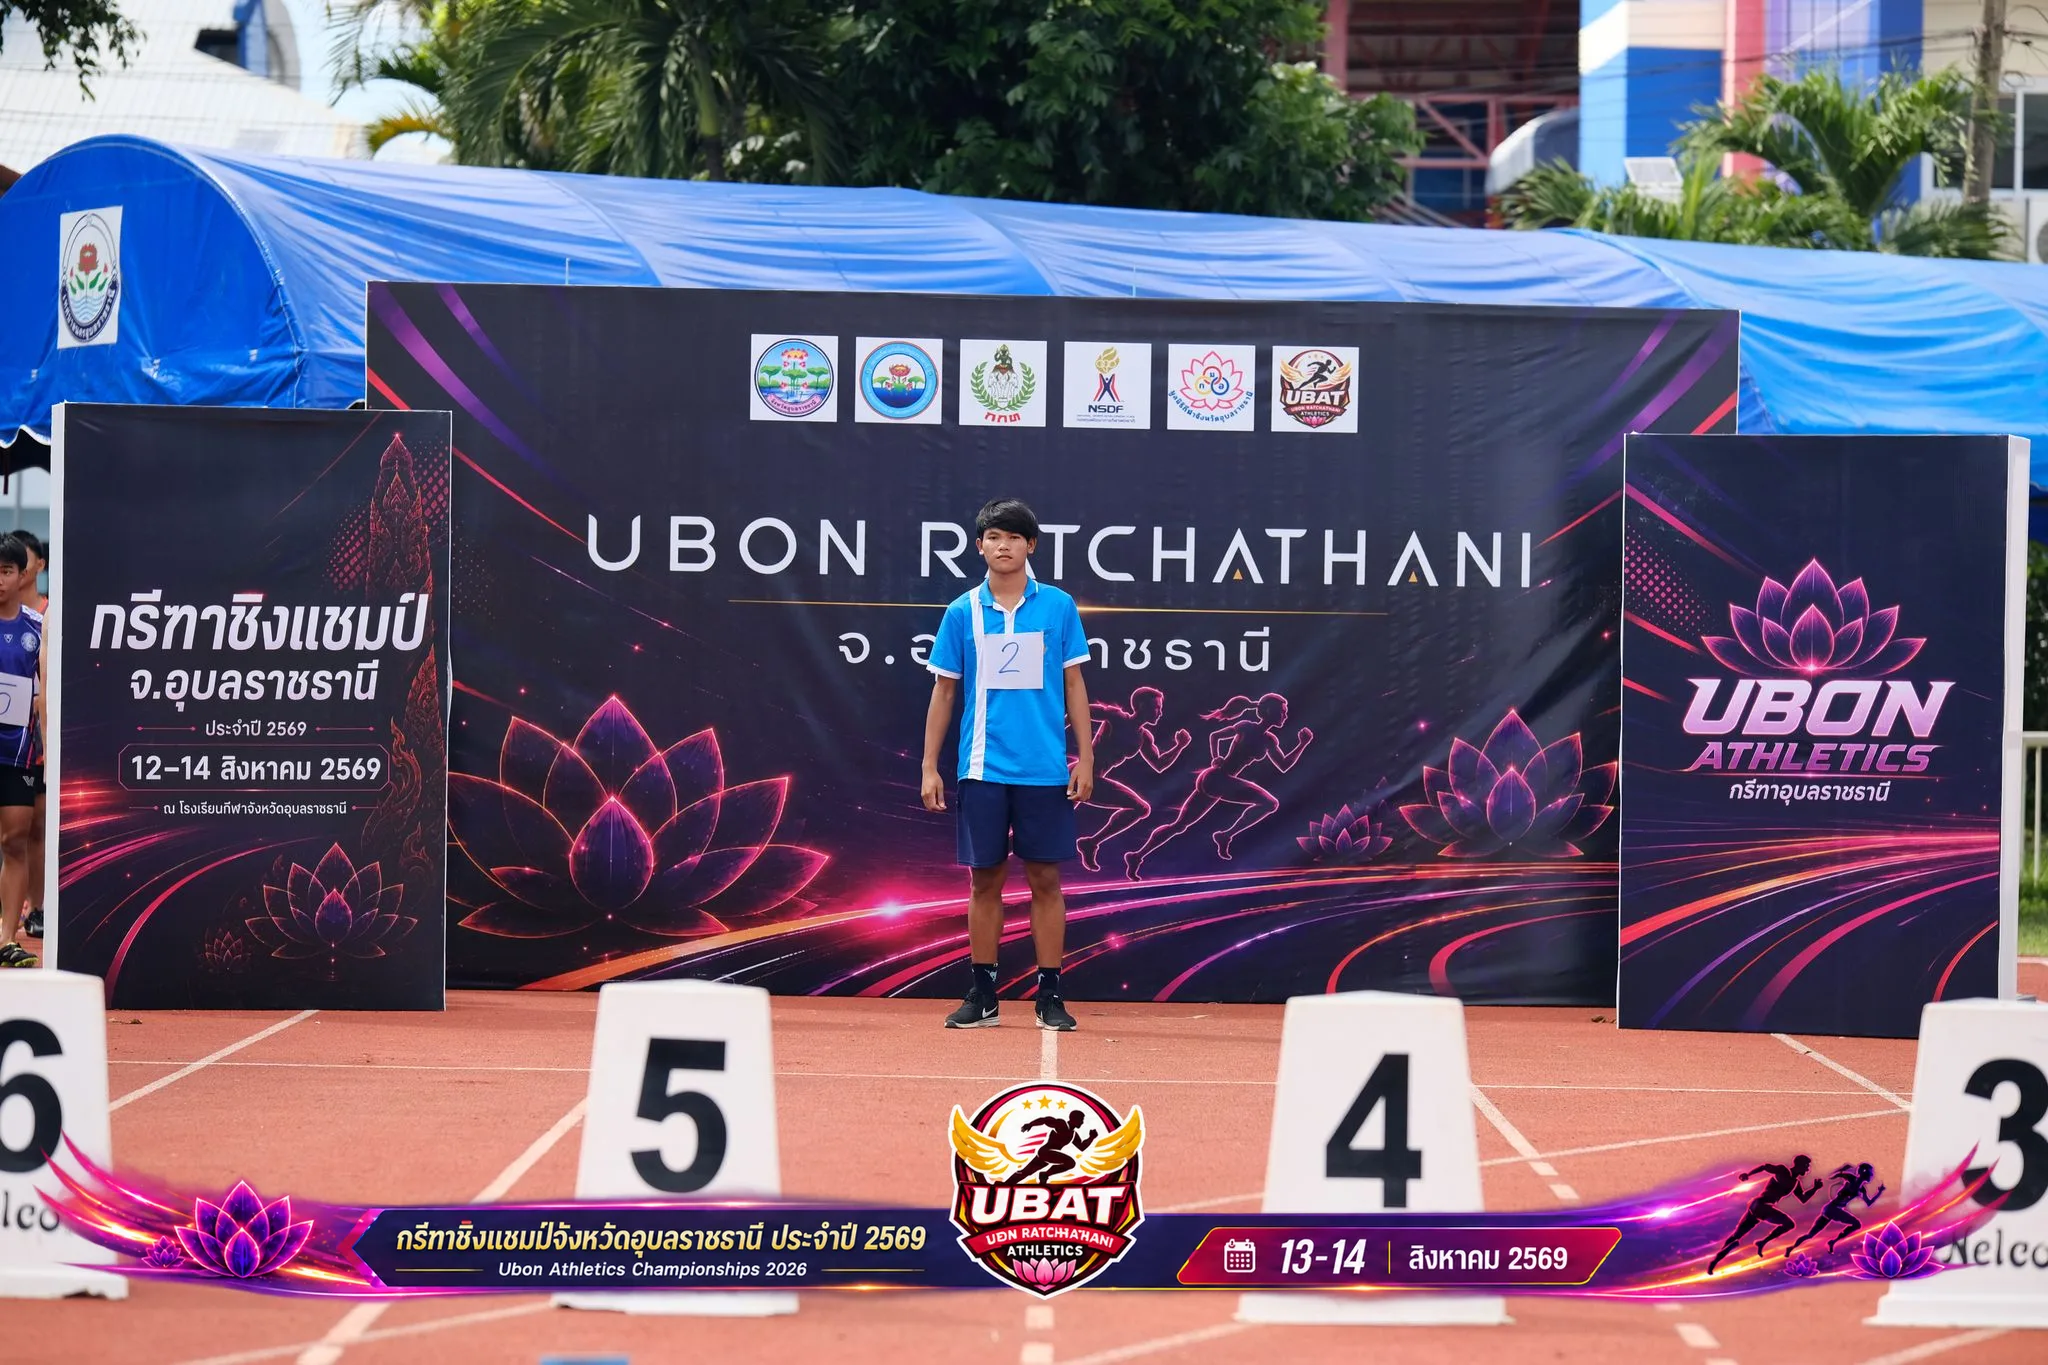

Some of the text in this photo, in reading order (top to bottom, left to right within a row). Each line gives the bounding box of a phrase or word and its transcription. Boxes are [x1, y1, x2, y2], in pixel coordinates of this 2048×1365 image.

[1088, 404, 1124, 413] NSDF
[1286, 390, 1345, 405] UBAT
[587, 513, 1532, 589] UBON RTCHATHANI
[90, 589, 430, 651] กรีฑาชิงแชมป์
[998, 641, 1020, 674] 2
[130, 659, 380, 712] จ.อุบลราชธานี
[205, 719, 307, 736] ประจำปี 2569
[1683, 678, 1956, 738] UBON
[220, 755, 311, 781] สิงหาคม
[320, 757, 381, 780] 2569
[1682, 741, 1943, 772] ATHLETICS
[163, 801, 347, 818] ณ โรงเรียนกีฬาจังหวัดอุบลราชธานี
[1729, 779, 1892, 807] กรีฑาอุบลราชธานี
[0, 1018, 63, 1173] 6
[631, 1038, 728, 1193] 5
[1324, 1052, 1423, 1210] 4
[1959, 1057, 2048, 1212] 3
